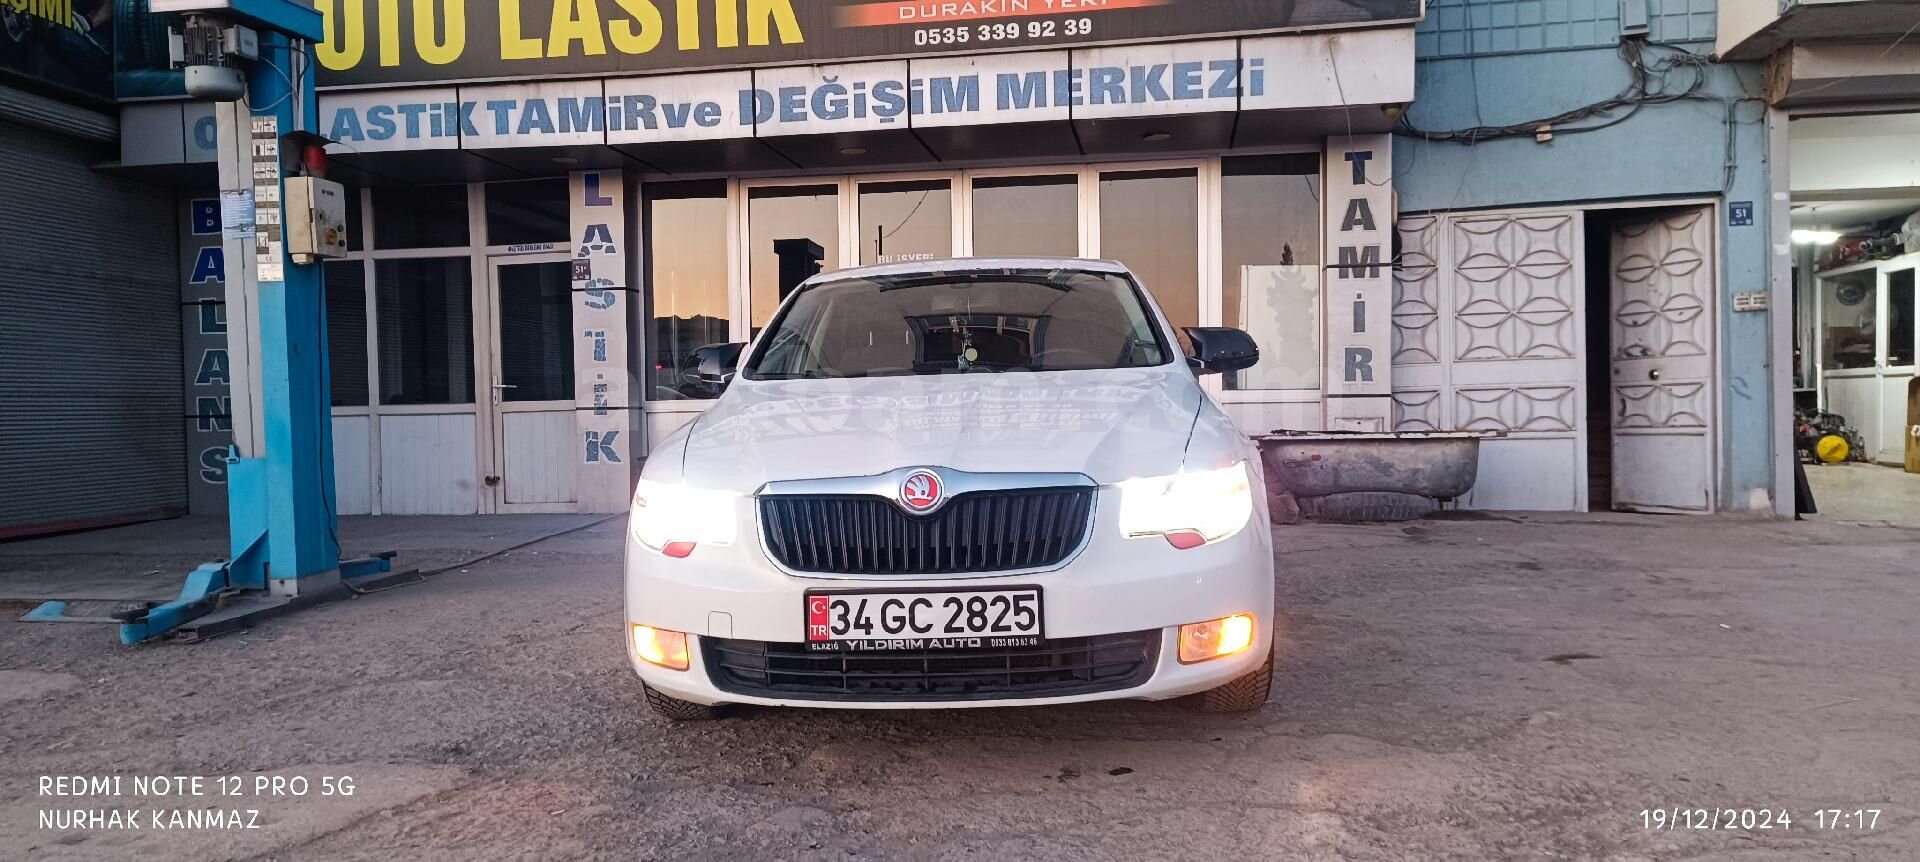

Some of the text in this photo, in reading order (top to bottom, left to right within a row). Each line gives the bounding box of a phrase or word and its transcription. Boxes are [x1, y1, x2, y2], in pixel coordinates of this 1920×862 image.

[899, 0, 1028, 19] DURAKIN
[914, 17, 1092, 46] 0535 339 92 39
[830, 594, 1036, 636] 34 GC 2825
[810, 624, 827, 637] TR
[846, 639, 924, 651] YILDIRIM
[929, 637, 981, 649] AUTO
